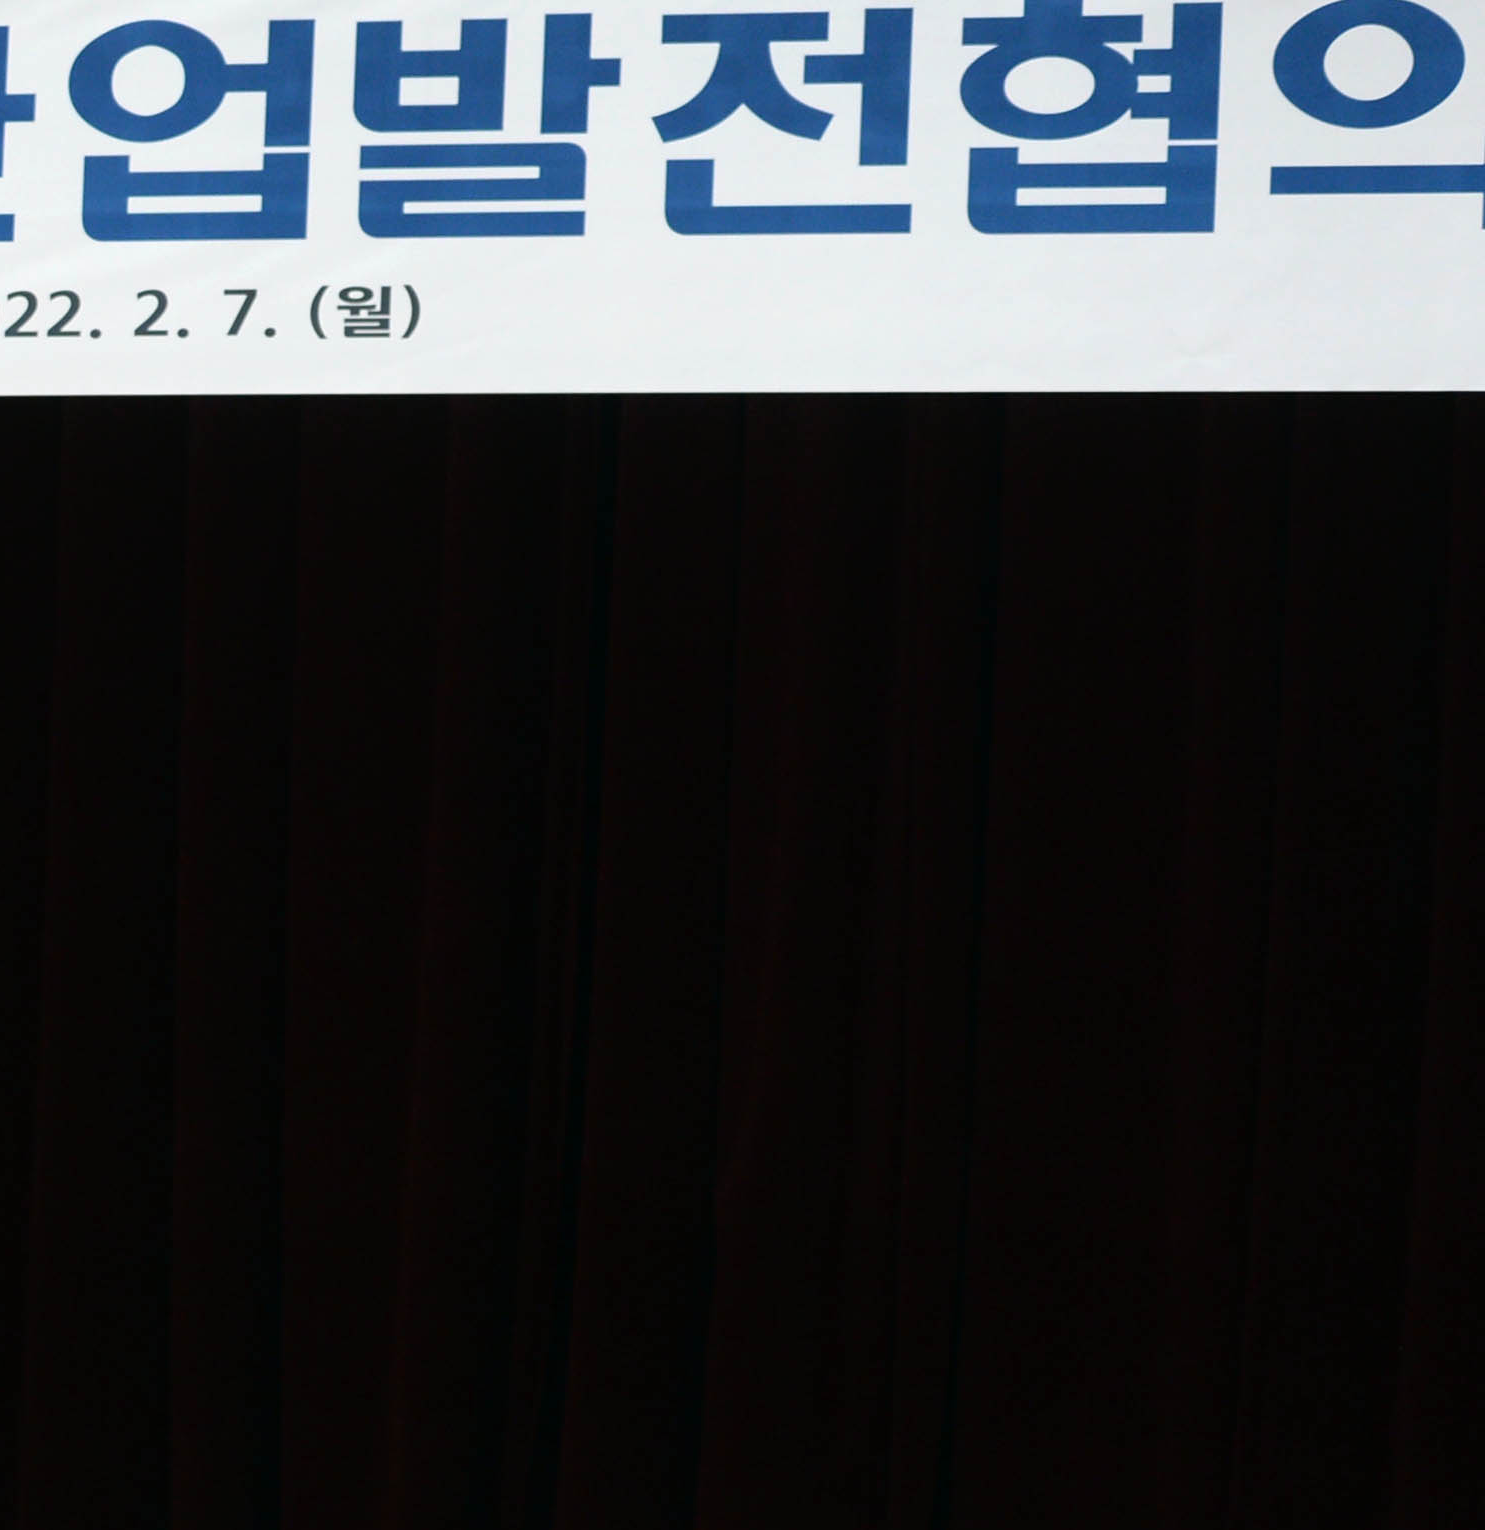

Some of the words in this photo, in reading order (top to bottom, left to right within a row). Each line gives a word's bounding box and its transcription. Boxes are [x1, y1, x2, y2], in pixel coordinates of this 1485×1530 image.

[134, 290, 188, 338] 2.
[224, 289, 275, 337] 7.
[310, 285, 420, 339] (월)
